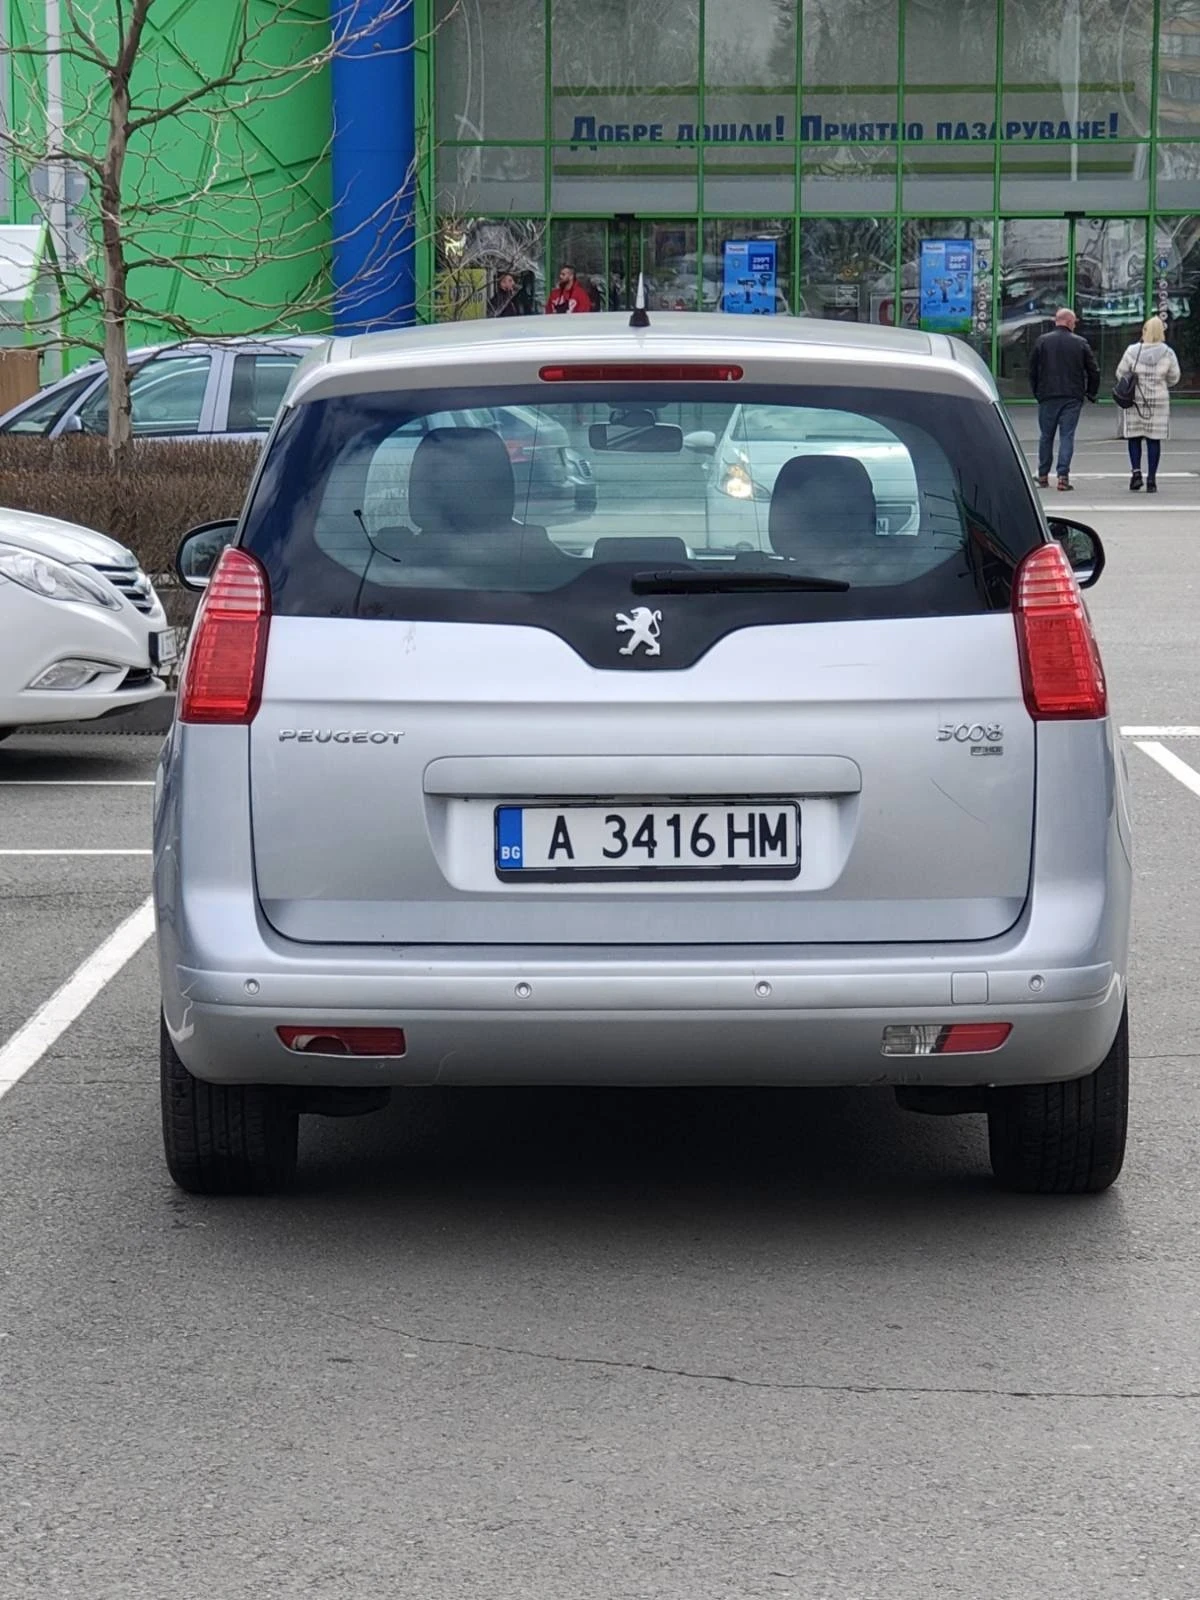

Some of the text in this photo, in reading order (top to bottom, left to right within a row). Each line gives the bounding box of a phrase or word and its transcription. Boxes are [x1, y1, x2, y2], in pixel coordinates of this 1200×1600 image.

[279, 729, 405, 744] PEUGEOT
[936, 724, 1003, 742] 5008
[548, 812, 788, 860] A 3416 HM
[501, 847, 521, 860] BG
